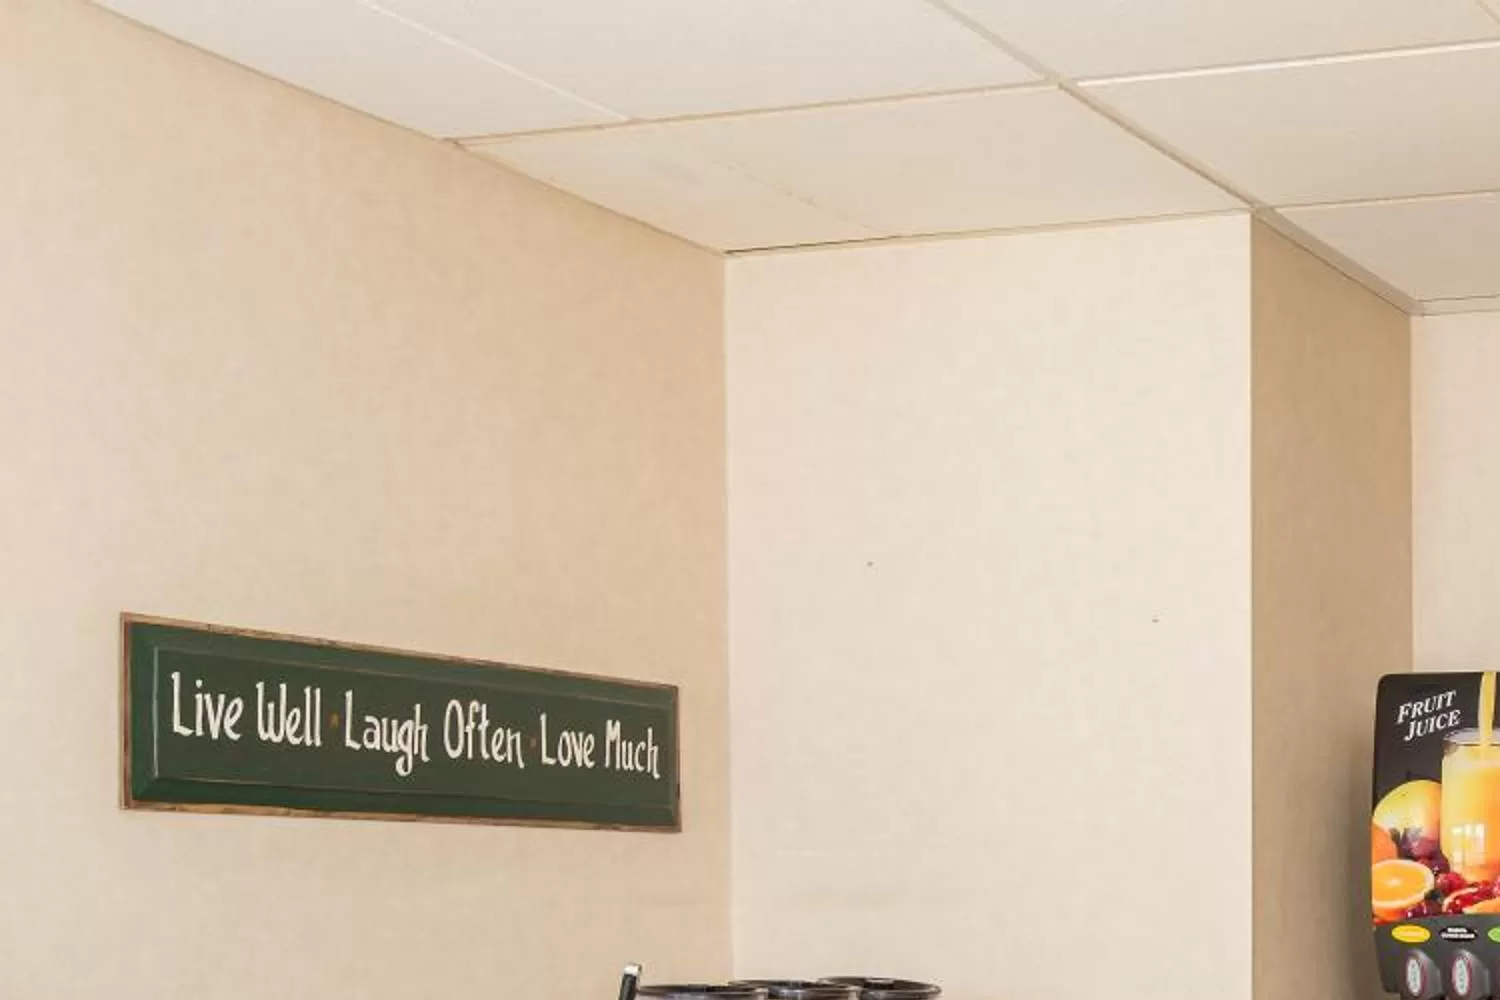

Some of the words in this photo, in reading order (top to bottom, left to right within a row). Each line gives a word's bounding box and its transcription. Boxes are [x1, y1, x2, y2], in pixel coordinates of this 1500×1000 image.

[1397, 690, 1456, 724] FRUIT
[171, 671, 243, 741] Live
[256, 681, 321, 747] Well
[345, 690, 430, 777] Laugh
[444, 699, 525, 768] Often
[540, 713, 595, 768] Love
[605, 720, 660, 779] Much
[1404, 709, 1461, 741] JUICE
